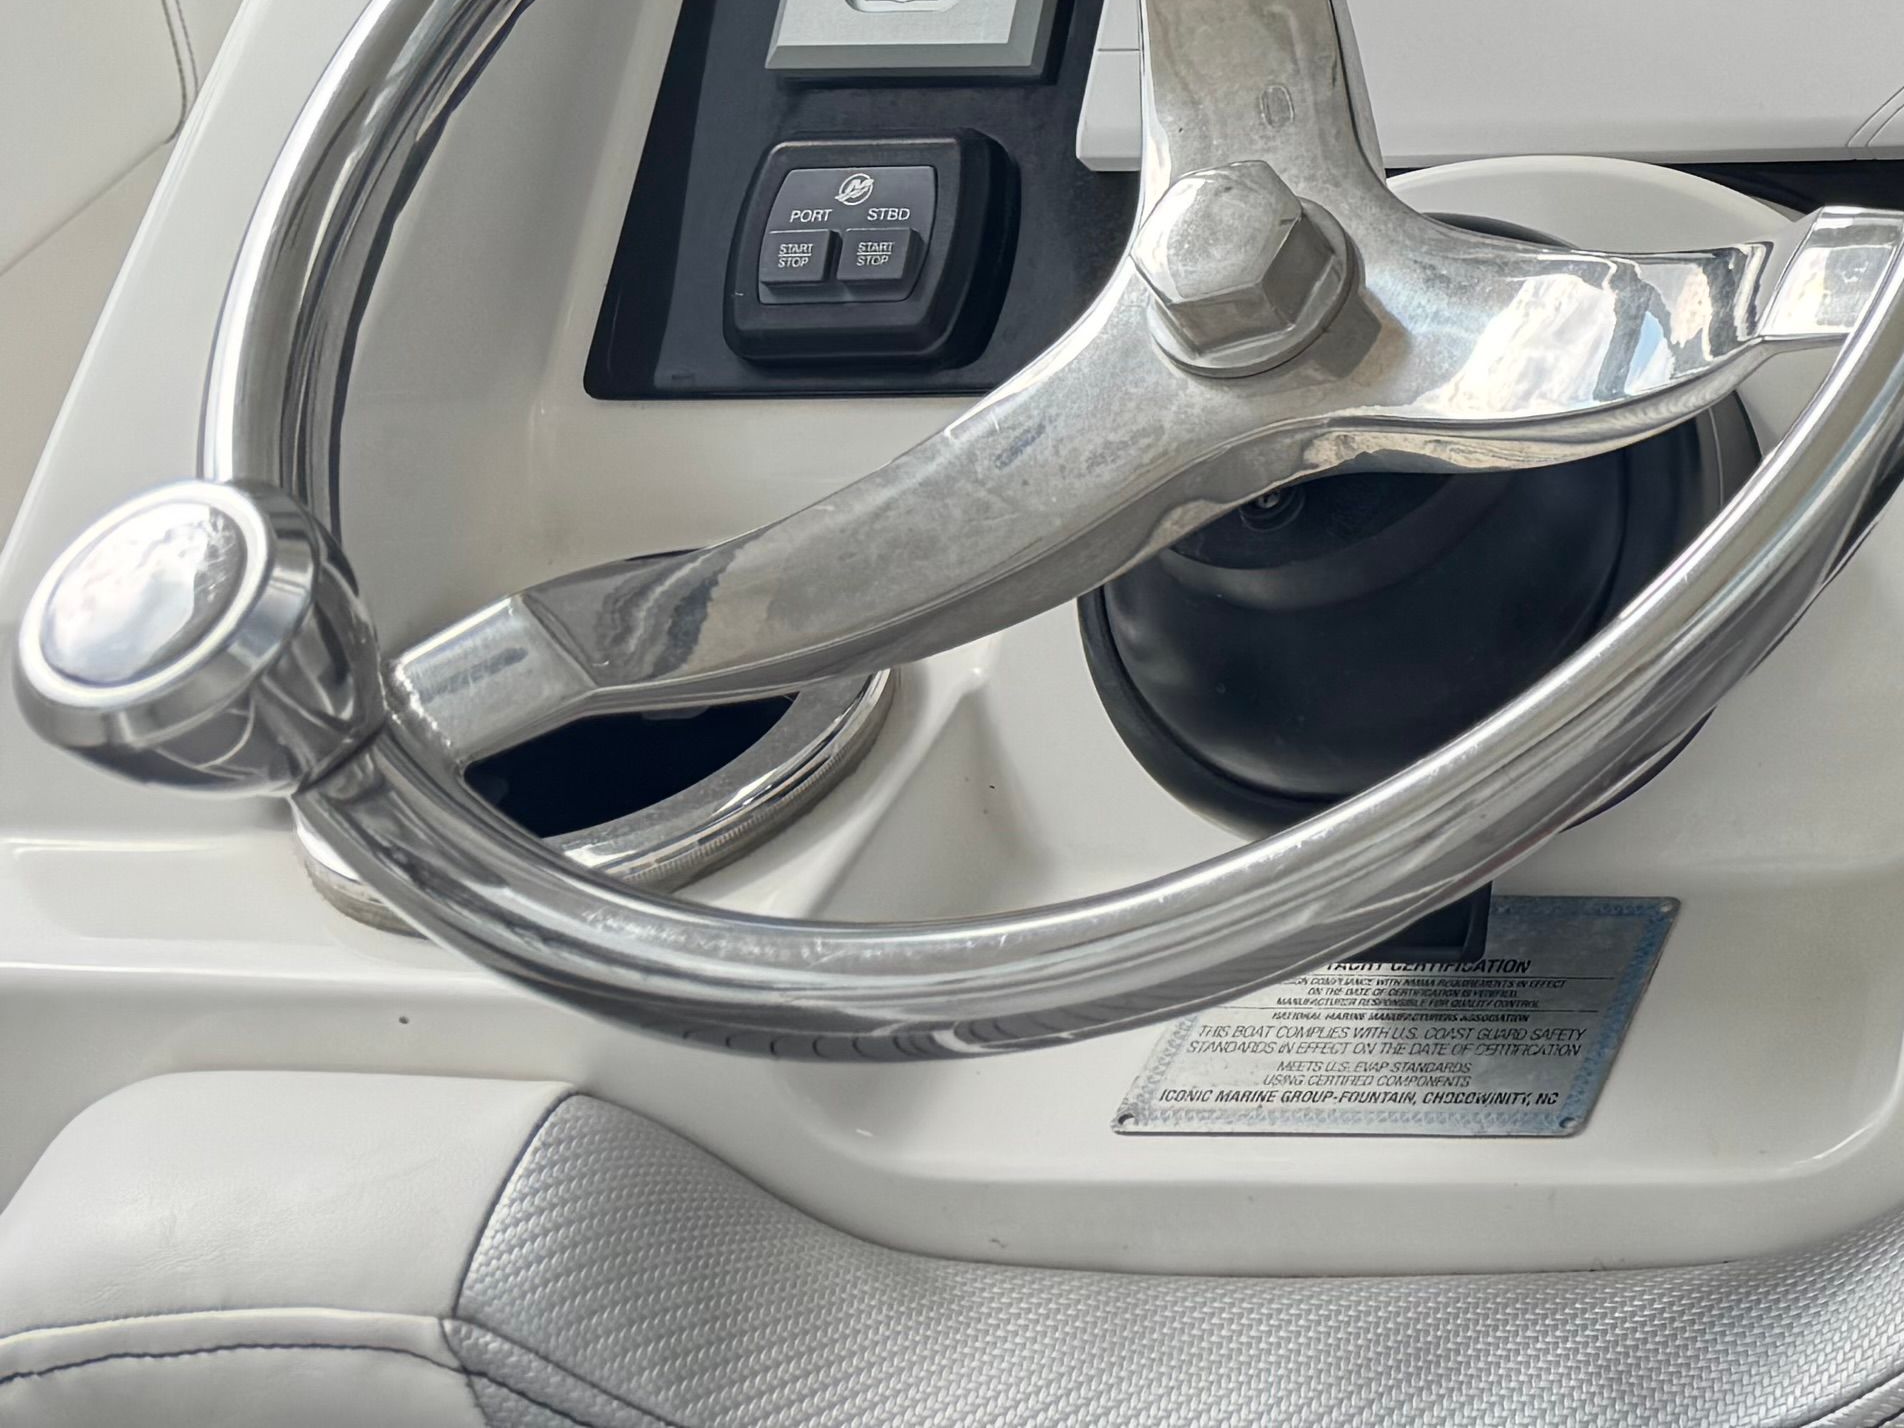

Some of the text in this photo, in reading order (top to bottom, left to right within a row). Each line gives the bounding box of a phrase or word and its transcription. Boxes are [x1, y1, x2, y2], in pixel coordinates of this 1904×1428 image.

[790, 209, 832, 223] PORT
[867, 207, 911, 221] STBD
[778, 243, 814, 254] START
[857, 242, 894, 253] START
[778, 256, 809, 268] STOP
[856, 255, 889, 267] STOP
[1199, 1025, 1588, 1041] THIS BOAT COMPLIES WITH U.S. COAST GUARD SAFETY
[1186, 1041, 1276, 1054] STANDARDS
[1296, 1042, 1351, 1054] EFFECT
[1352, 1042, 1379, 1054] ON
[1380, 1043, 1406, 1055] THE
[1408, 1043, 1450, 1056] DATE
[1451, 1043, 1474, 1056] OF
[1277, 1061, 1323, 1072] MEETS
[1390, 1062, 1472, 1074] STANDARDS
[1263, 1074, 1472, 1088] USING CERTIFIED COMPONENTS
[1159, 1089, 1214, 1103] ICONIC
[1215, 1089, 1277, 1103] MARINE
[1535, 1093, 1559, 1105] NC
